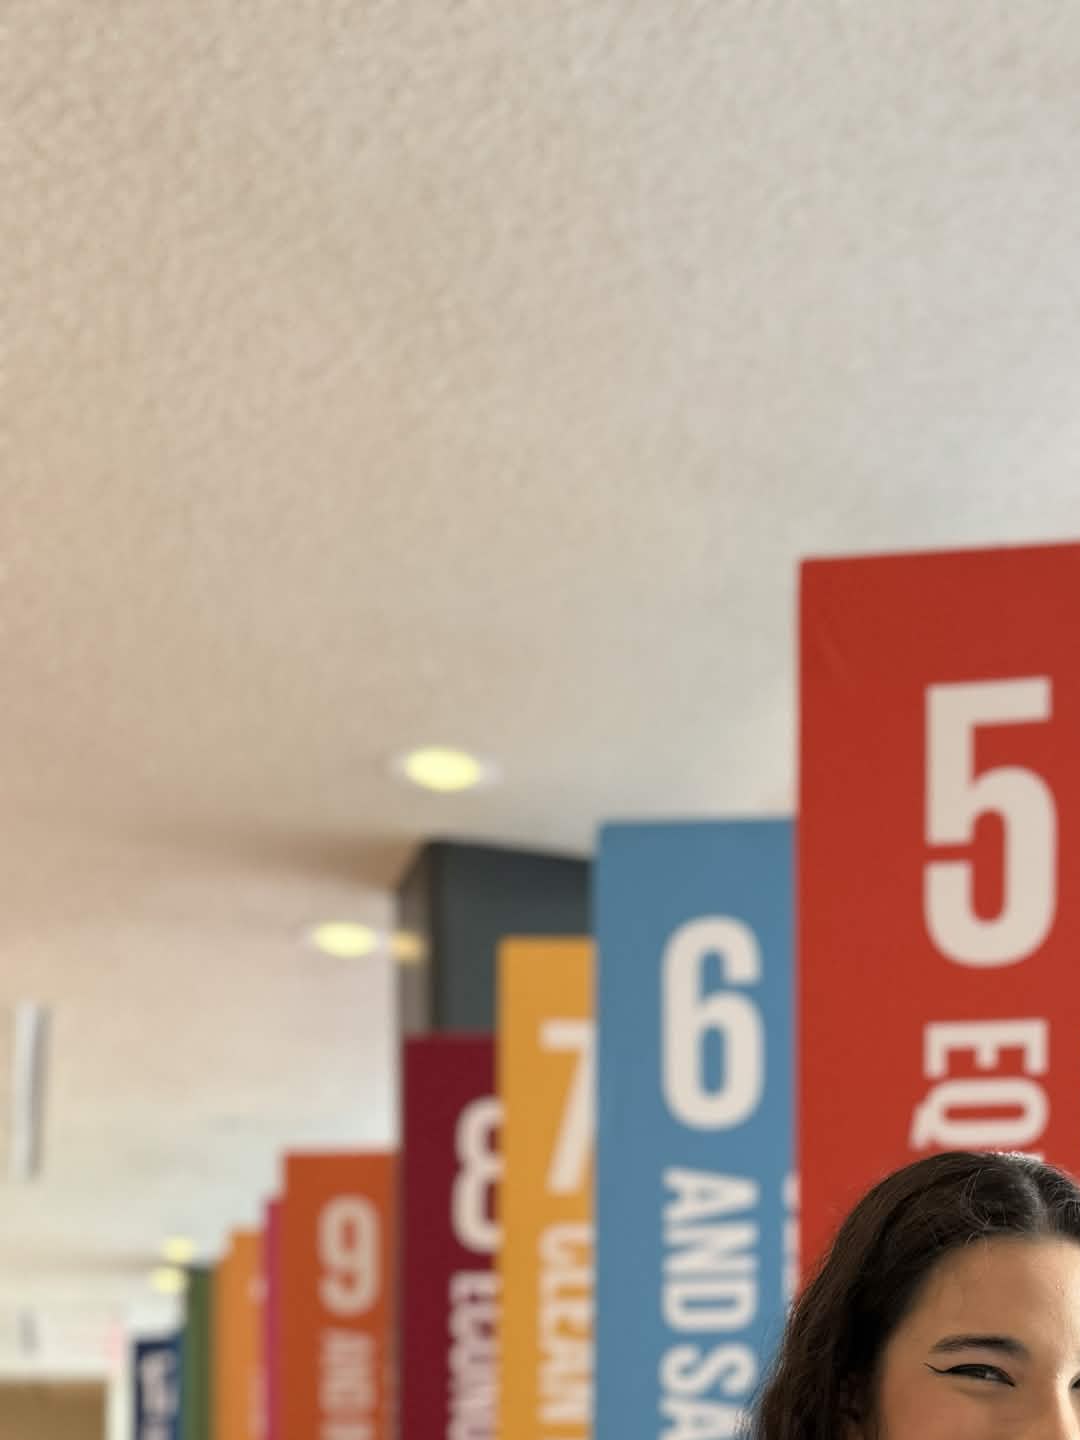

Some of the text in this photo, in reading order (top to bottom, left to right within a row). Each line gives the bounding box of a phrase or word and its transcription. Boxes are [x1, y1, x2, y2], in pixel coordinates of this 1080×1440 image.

[924, 677, 1058, 967] 5
[539, 1019, 595, 1195] 7
[660, 914, 765, 1130] 6
[319, 1195, 380, 1316] 9
[452, 1097, 502, 1254] 8
[660, 1166, 760, 1333] AND
